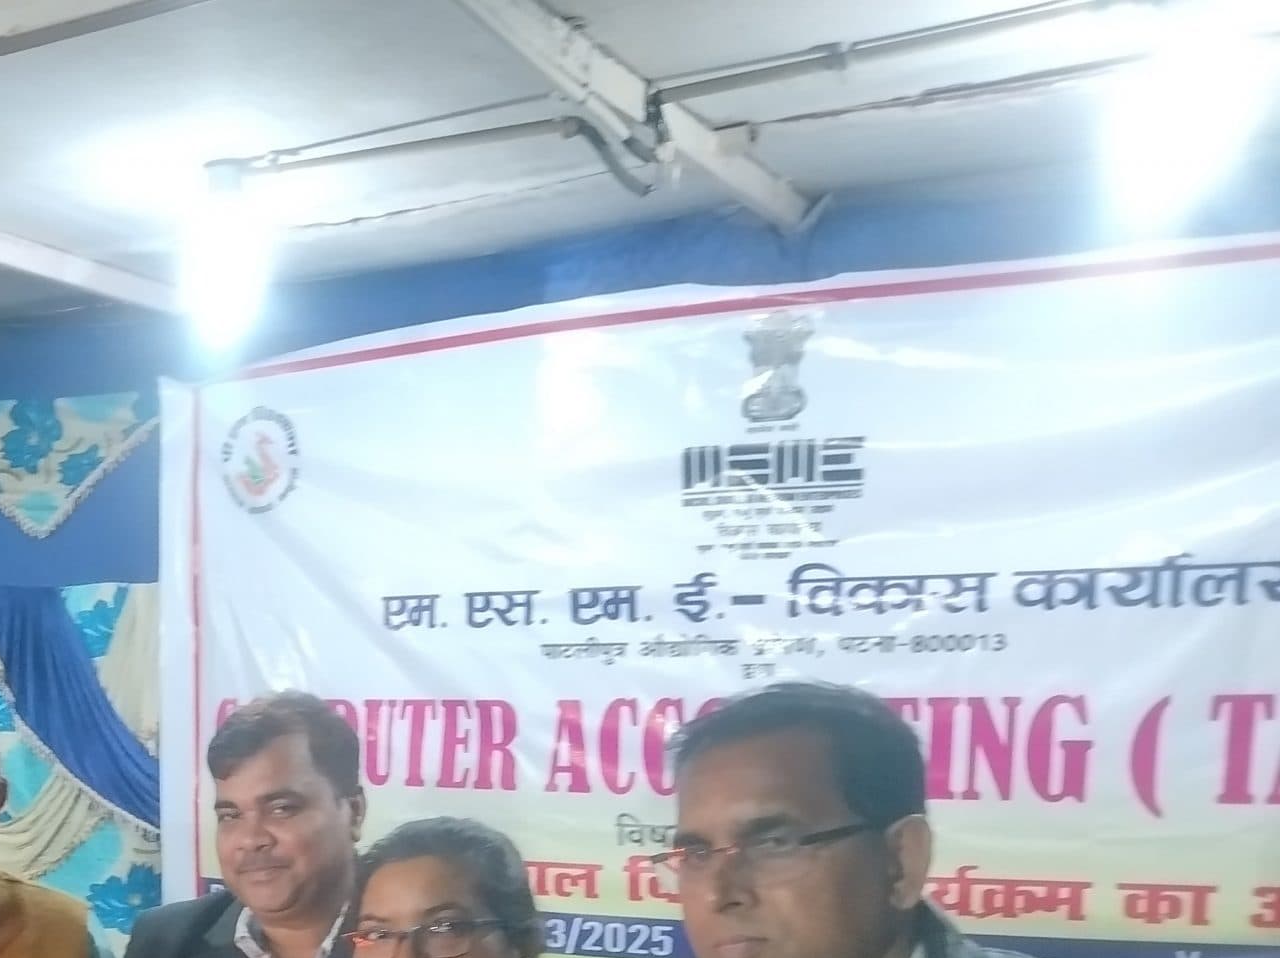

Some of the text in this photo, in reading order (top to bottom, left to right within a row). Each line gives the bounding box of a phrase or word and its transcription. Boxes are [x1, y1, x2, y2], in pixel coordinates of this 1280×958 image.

[382, 593, 448, 630] एम.
[464, 589, 548, 628] एस.
[569, 584, 653, 624] एम.
[787, 562, 998, 618] विकास
[1207, 693, 1280, 804] T
[1116, 883, 1218, 926] का
[546, 917, 674, 956] 3/2025
